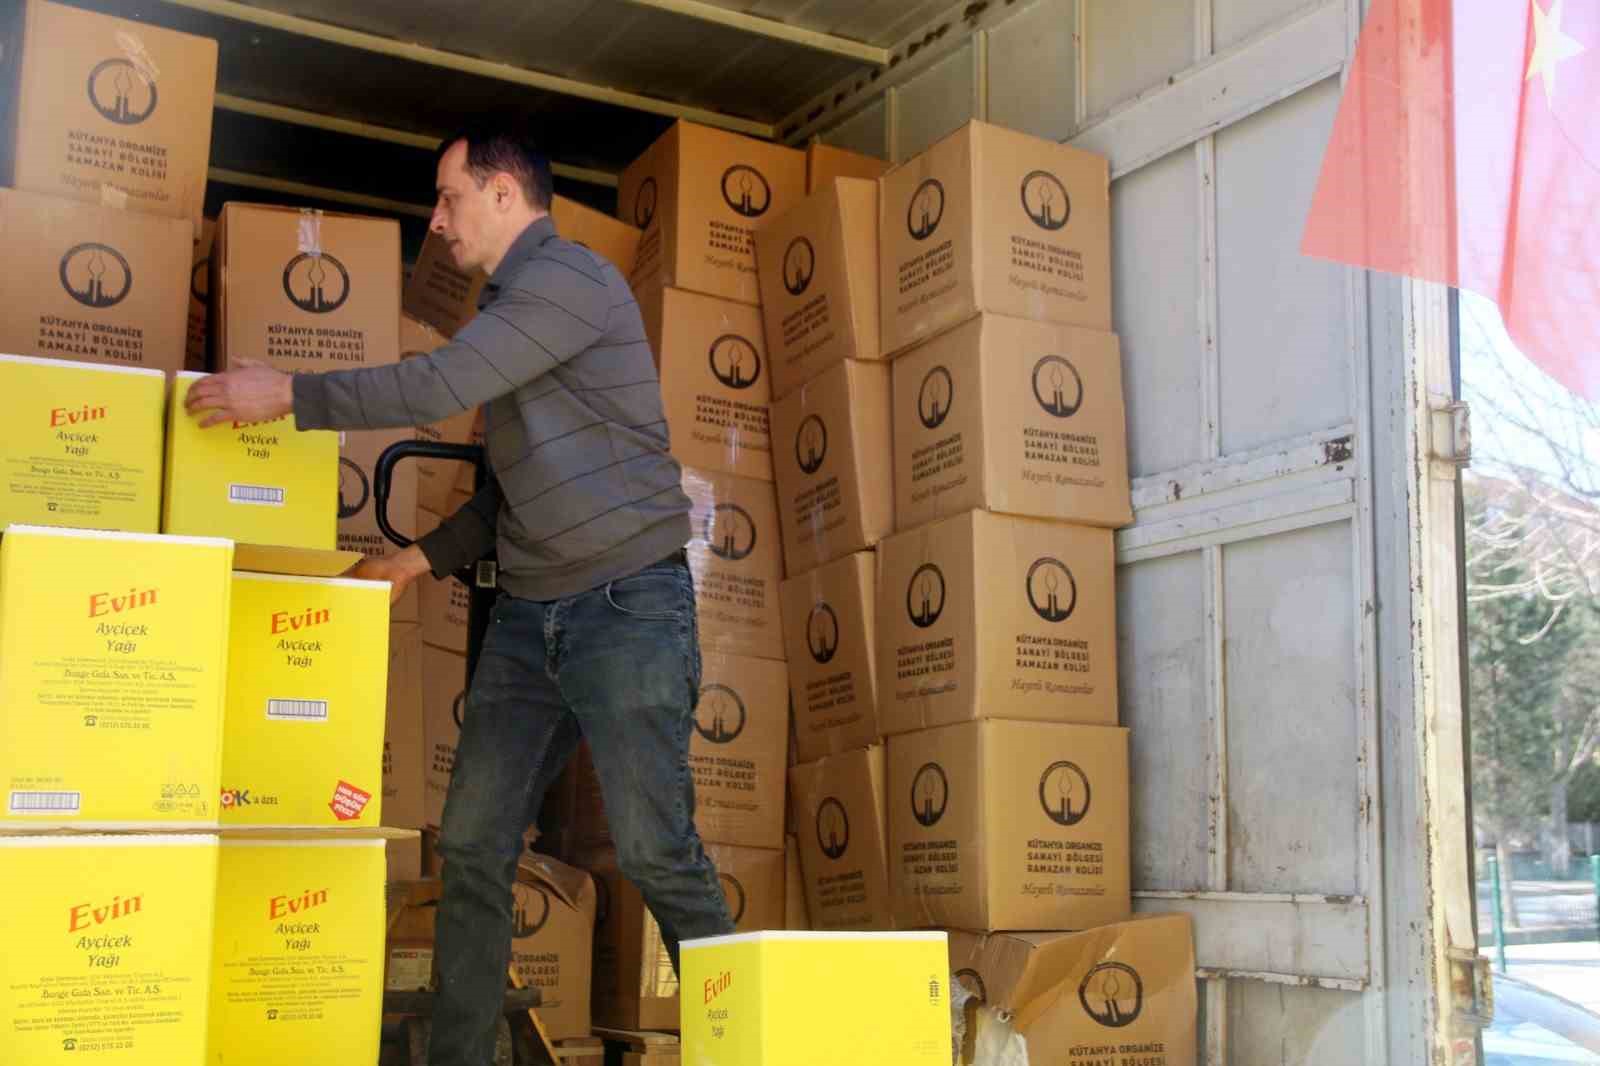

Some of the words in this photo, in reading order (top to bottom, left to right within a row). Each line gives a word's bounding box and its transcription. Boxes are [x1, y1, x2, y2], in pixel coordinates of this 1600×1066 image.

[39, 314, 90, 331] KÜTAHYA
[92, 324, 143, 338] ORGANİZE
[268, 324, 314, 336] KÜTAHYA
[316, 328, 363, 339] ORGANİZE
[40, 328, 86, 342] SANAYİ
[93, 335, 143, 350] BÖLGESİ
[269, 337, 311, 347] SANAYİ
[318, 339, 364, 350] BÖLGESİ
[38, 340, 97, 356] RAMAZAN
[104, 349, 142, 361] KOLİSİ
[268, 347, 322, 358] RAMAZAN
[329, 351, 364, 362] KOLİSİ
[50, 404, 107, 427] Evin
[88, 588, 158, 618] Evin
[271, 607, 331, 634] Evin
[96, 622, 149, 636] Ayçiçek
[106, 639, 137, 653] Yağı
[277, 639, 321, 652] Ayçiçek
[1016, 634, 1051, 645] KÜTAHYA
[1053, 638, 1088, 650] ORGANİZE
[1017, 646, 1049, 657] SANAYİ
[1055, 649, 1088, 661] BÖLGESİ
[286, 655, 313, 668] Yağı
[1016, 659, 1058, 670] RAMAZAN
[1064, 662, 1089, 673] KOLİSİ
[1027, 838, 1063, 849] KÜTAHYA
[1065, 841, 1103, 851] ORGANİZE
[1027, 851, 1062, 861] SANAYİ
[1066, 852, 1103, 863] BÖLGESİ
[1027, 864, 1072, 874] RAMAZAN
[1075, 865, 1103, 875] KOLİSİ
[269, 888, 327, 920] Evin
[68, 895, 143, 933] Evin
[76, 934, 132, 950] Ayçiçek
[285, 938, 311, 951] Yağı
[88, 953, 120, 968] Yağı
[704, 971, 731, 1005] Evin
